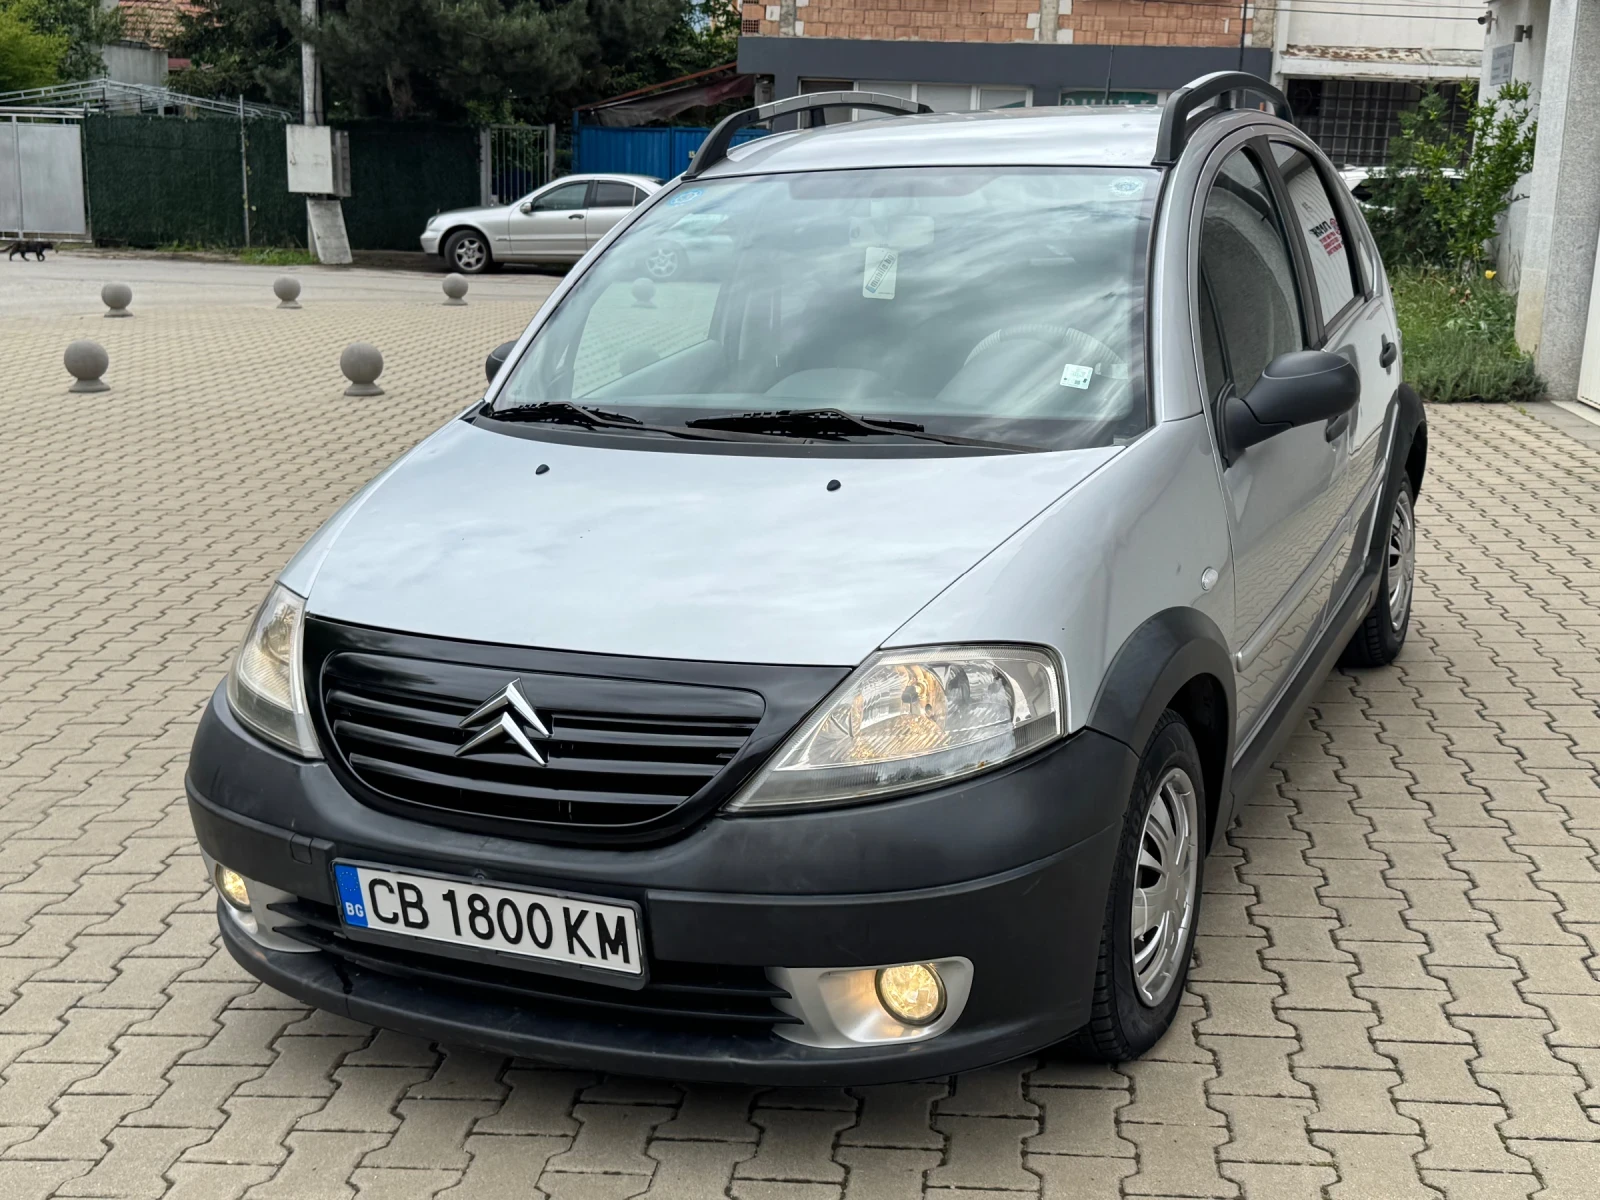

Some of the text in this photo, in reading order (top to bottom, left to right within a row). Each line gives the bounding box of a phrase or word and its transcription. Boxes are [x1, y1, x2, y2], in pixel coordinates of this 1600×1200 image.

[345, 901, 364, 918] BG
[368, 878, 631, 964] CB 1800 KM
